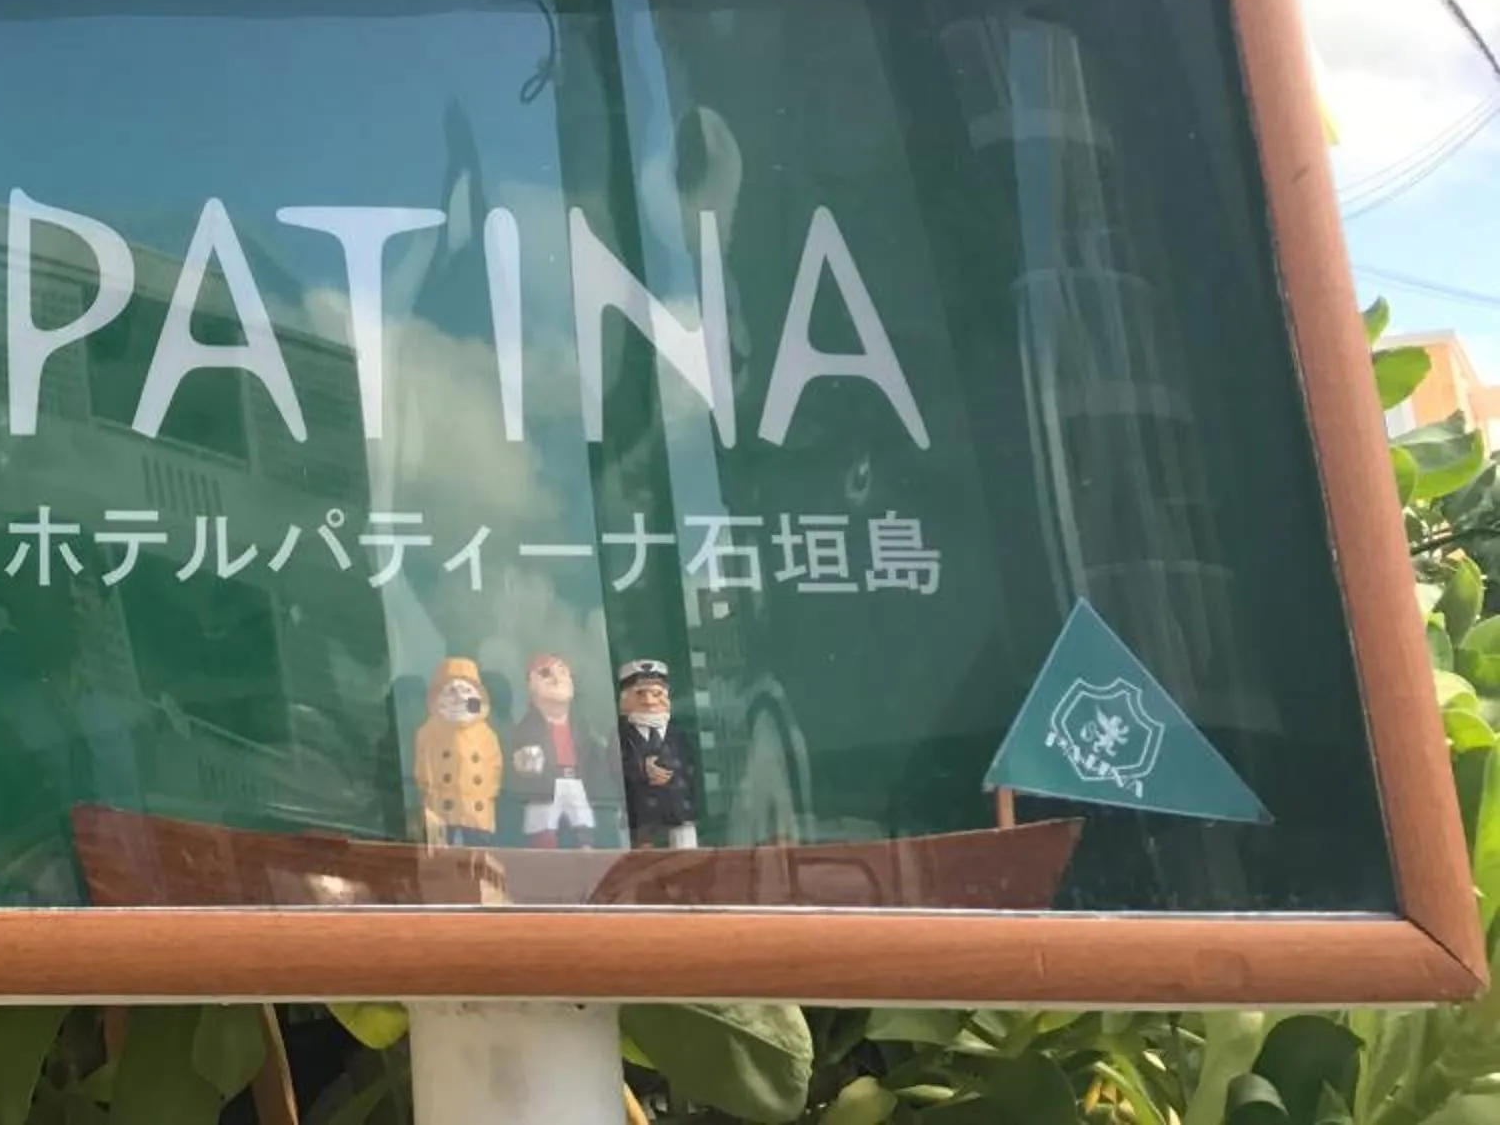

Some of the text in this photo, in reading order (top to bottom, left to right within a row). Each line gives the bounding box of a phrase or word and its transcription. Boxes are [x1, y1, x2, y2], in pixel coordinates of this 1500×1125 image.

[6, 188, 930, 449] PATINA
[4, 505, 942, 595] ホテルパティーナ石垣島
